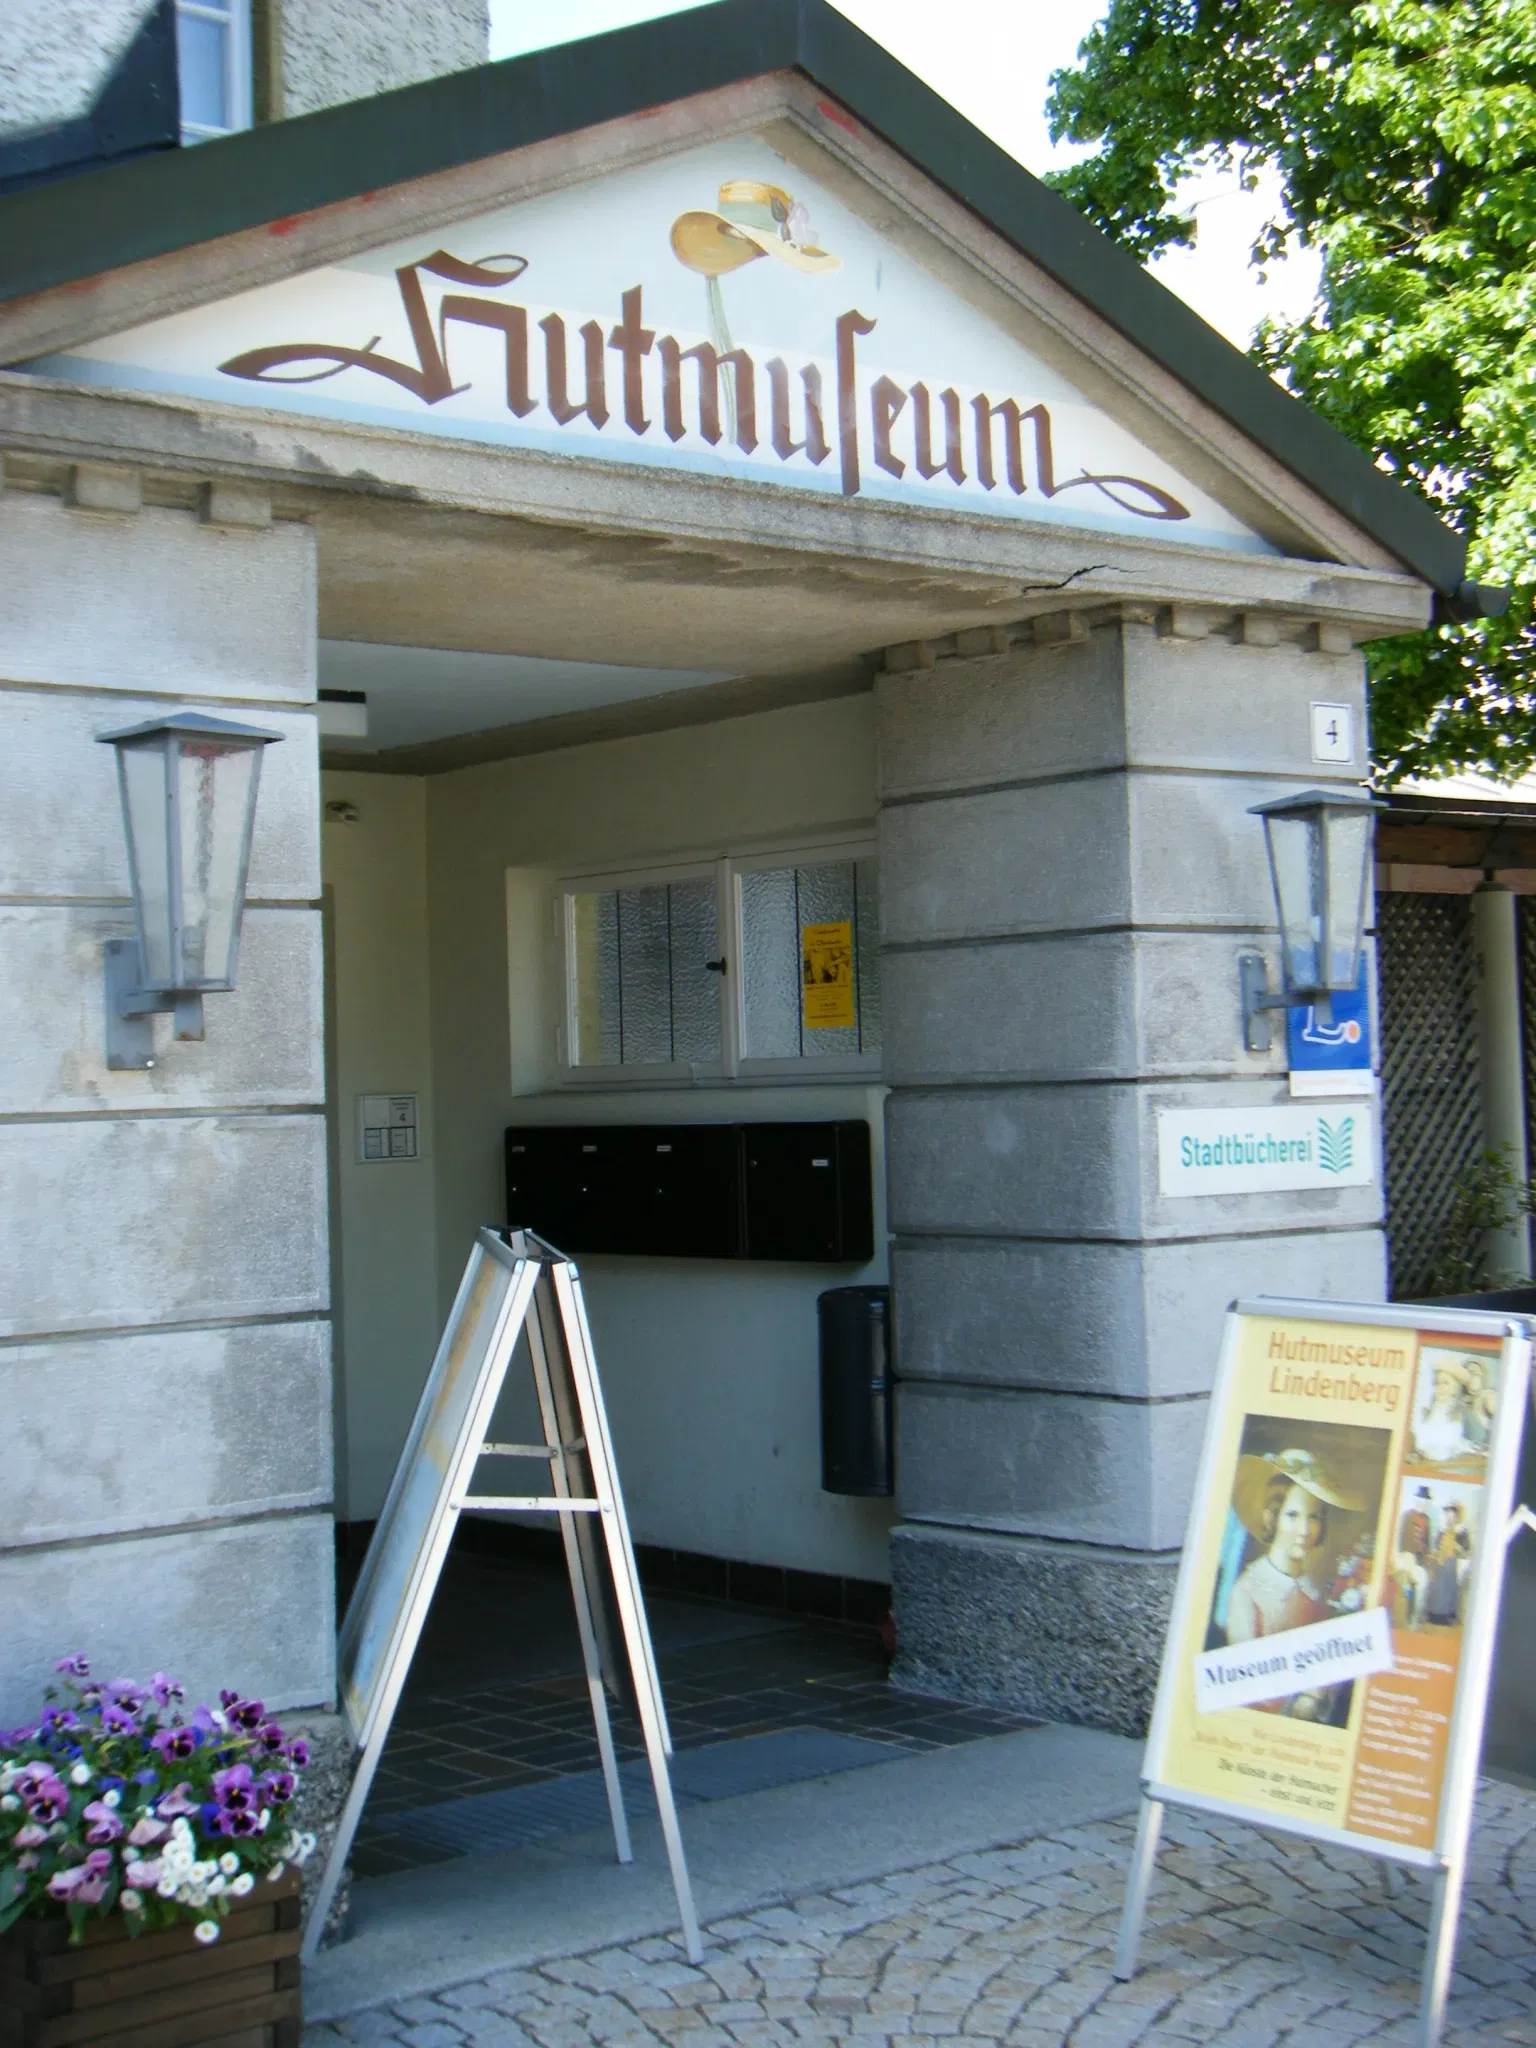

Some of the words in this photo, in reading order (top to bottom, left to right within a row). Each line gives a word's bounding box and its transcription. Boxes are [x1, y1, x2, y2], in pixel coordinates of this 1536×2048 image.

[1181, 1132, 1313, 1168] Stadtbücherei
[1269, 1331, 1405, 1369] Hutmuseum
[1270, 1366, 1401, 1412] Lindenberg
[1204, 1655, 1288, 1688] Museum
[1293, 1633, 1373, 1673] geöffnet
